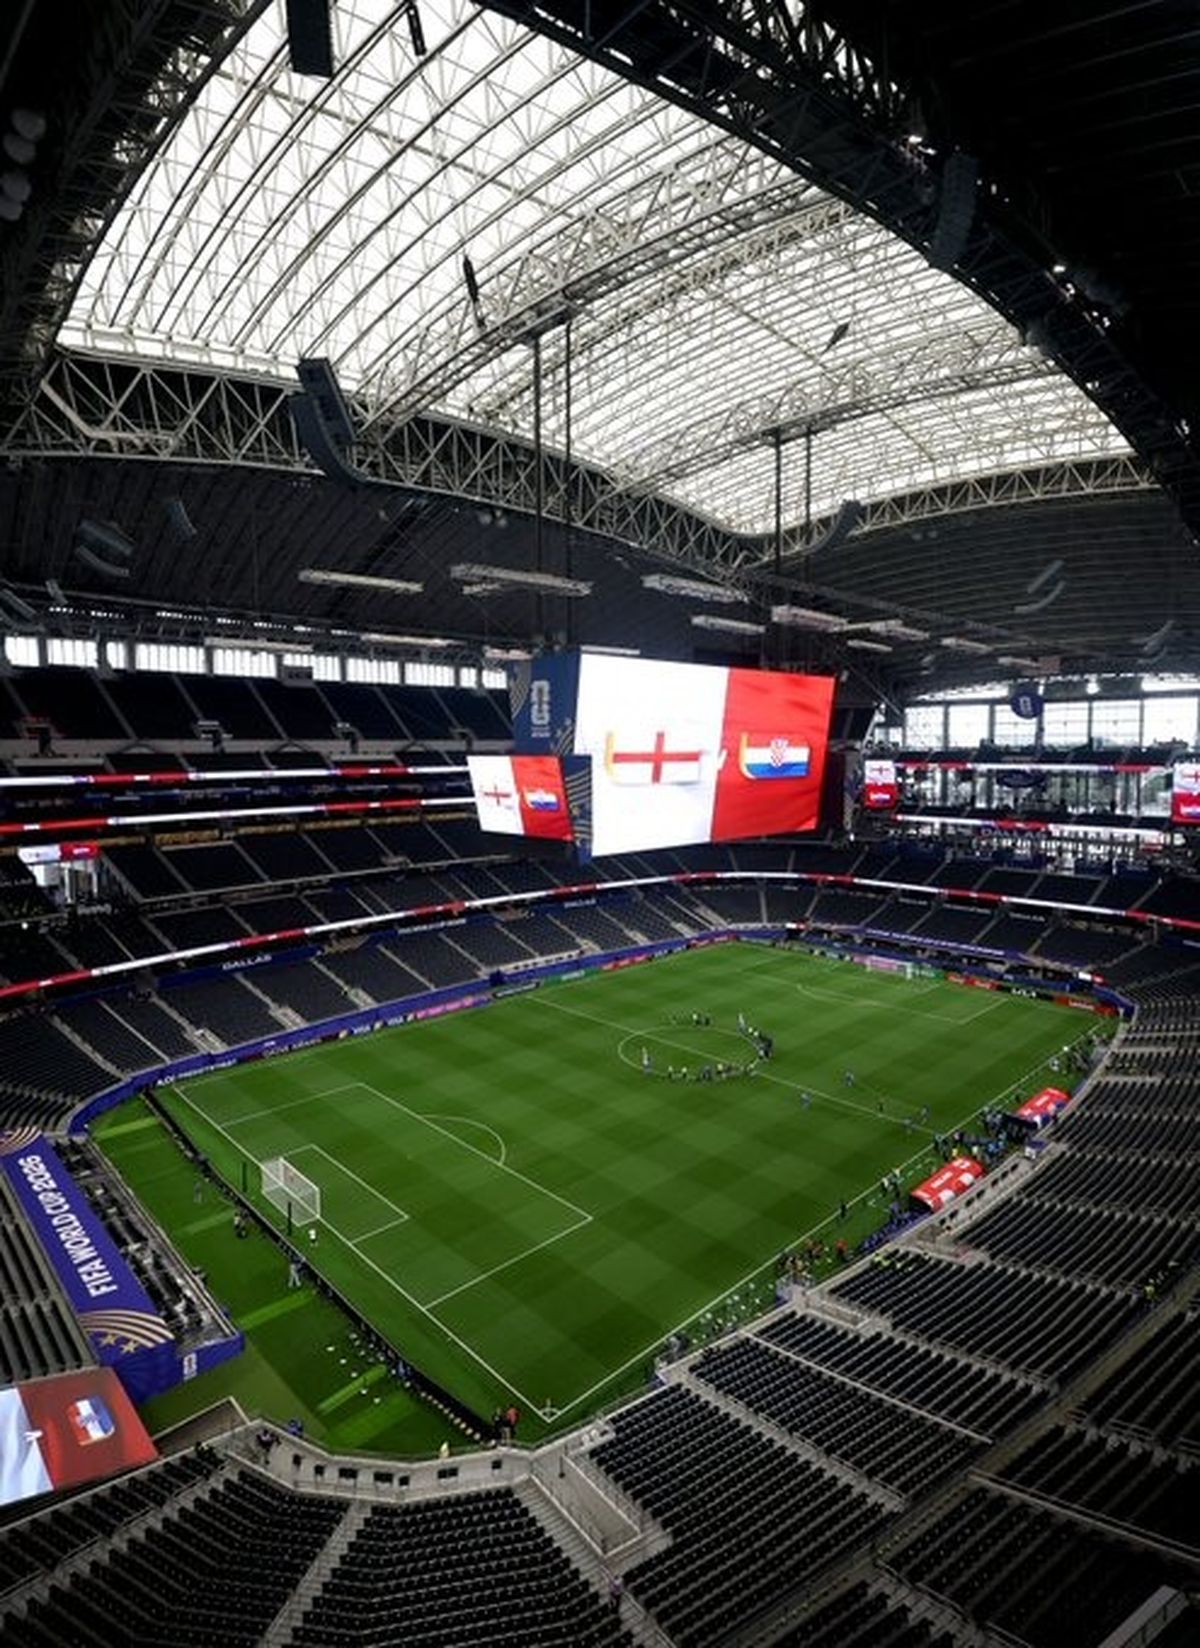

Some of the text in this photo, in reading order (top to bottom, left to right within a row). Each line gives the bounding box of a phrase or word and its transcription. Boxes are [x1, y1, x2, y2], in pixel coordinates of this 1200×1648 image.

[222, 954, 272, 971] DALLAS
[18, 1155, 118, 1297] FIFA WORLD CUP 2026
